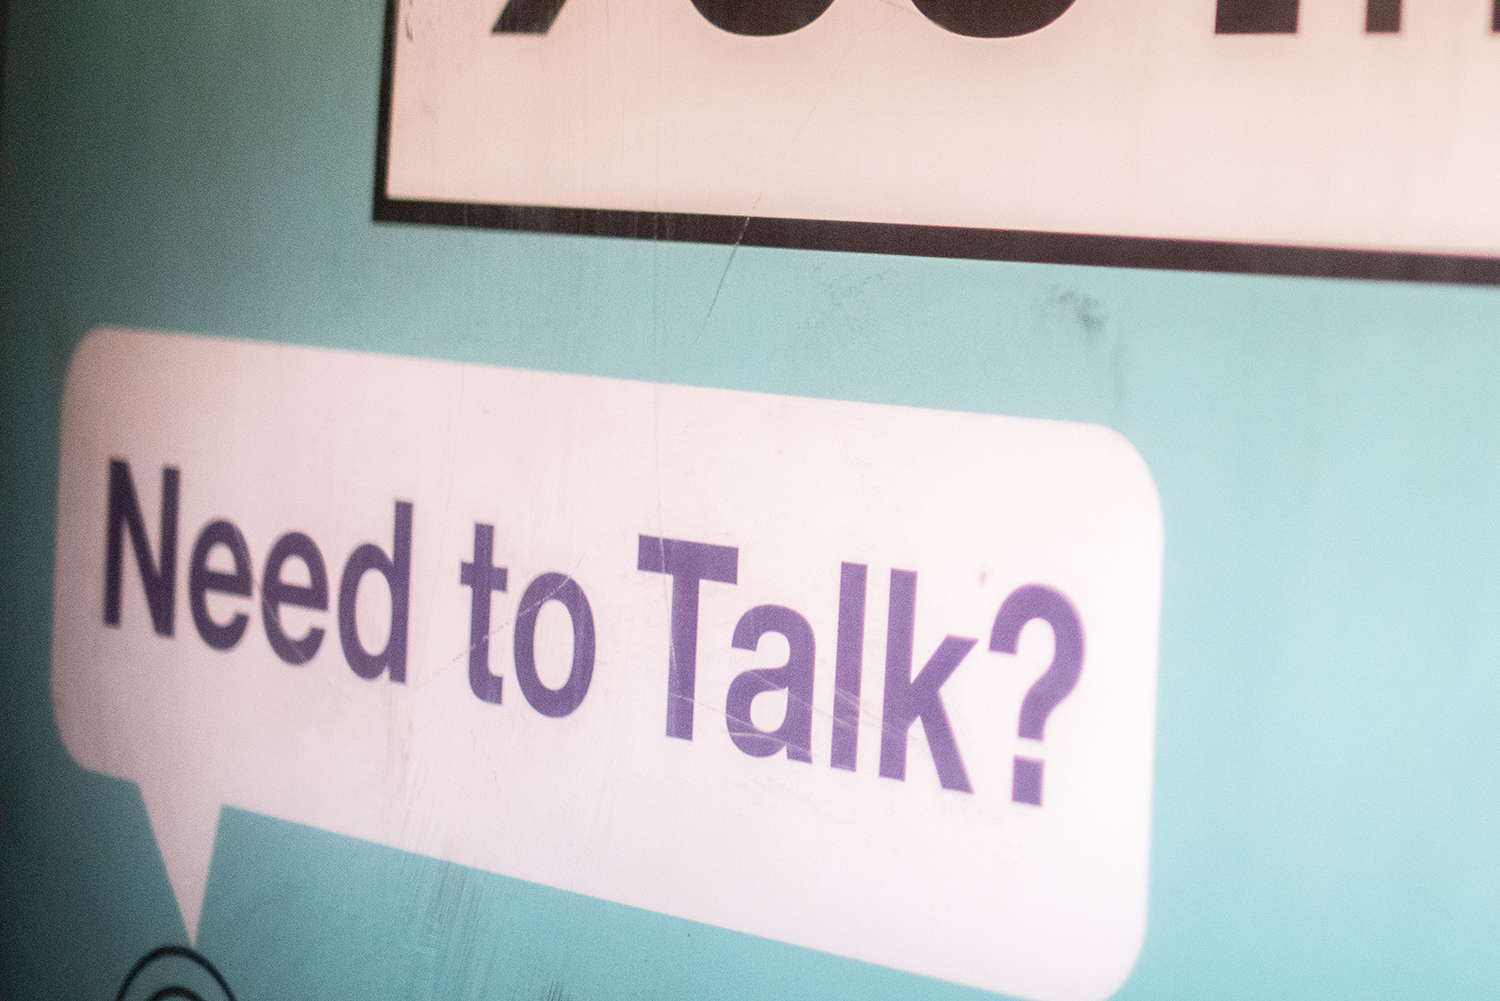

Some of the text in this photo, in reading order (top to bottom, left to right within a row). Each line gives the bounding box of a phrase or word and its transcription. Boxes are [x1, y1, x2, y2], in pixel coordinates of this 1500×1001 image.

[101, 455, 1087, 808] Need to Talk?
